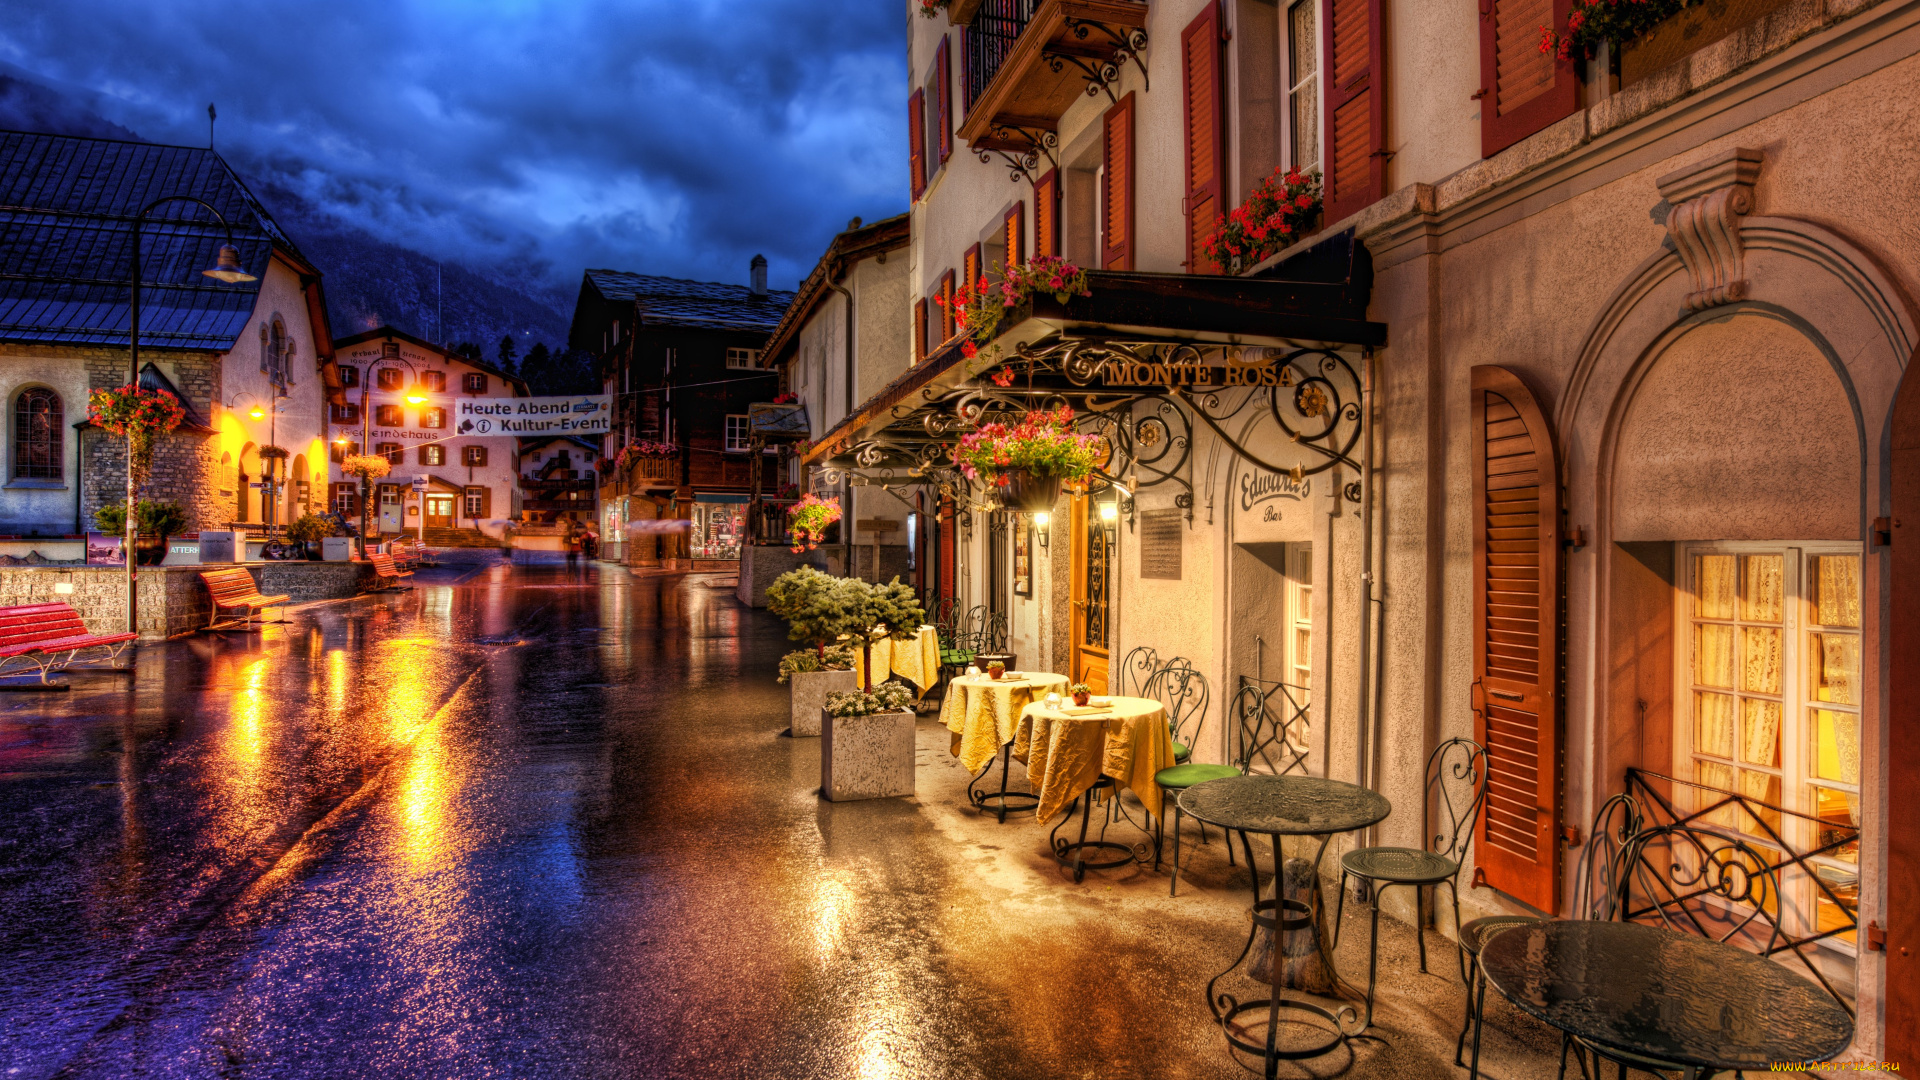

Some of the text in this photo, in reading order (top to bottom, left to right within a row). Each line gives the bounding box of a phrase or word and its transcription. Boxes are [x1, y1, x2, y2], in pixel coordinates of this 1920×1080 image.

[1107, 363, 1295, 387] MONTE ROSA
[462, 401, 569, 415] Heute Abend
[501, 416, 608, 431] Kultur-Event
[1263, 505, 1283, 522] Bar
[169, 546, 200, 554] ATTERH
